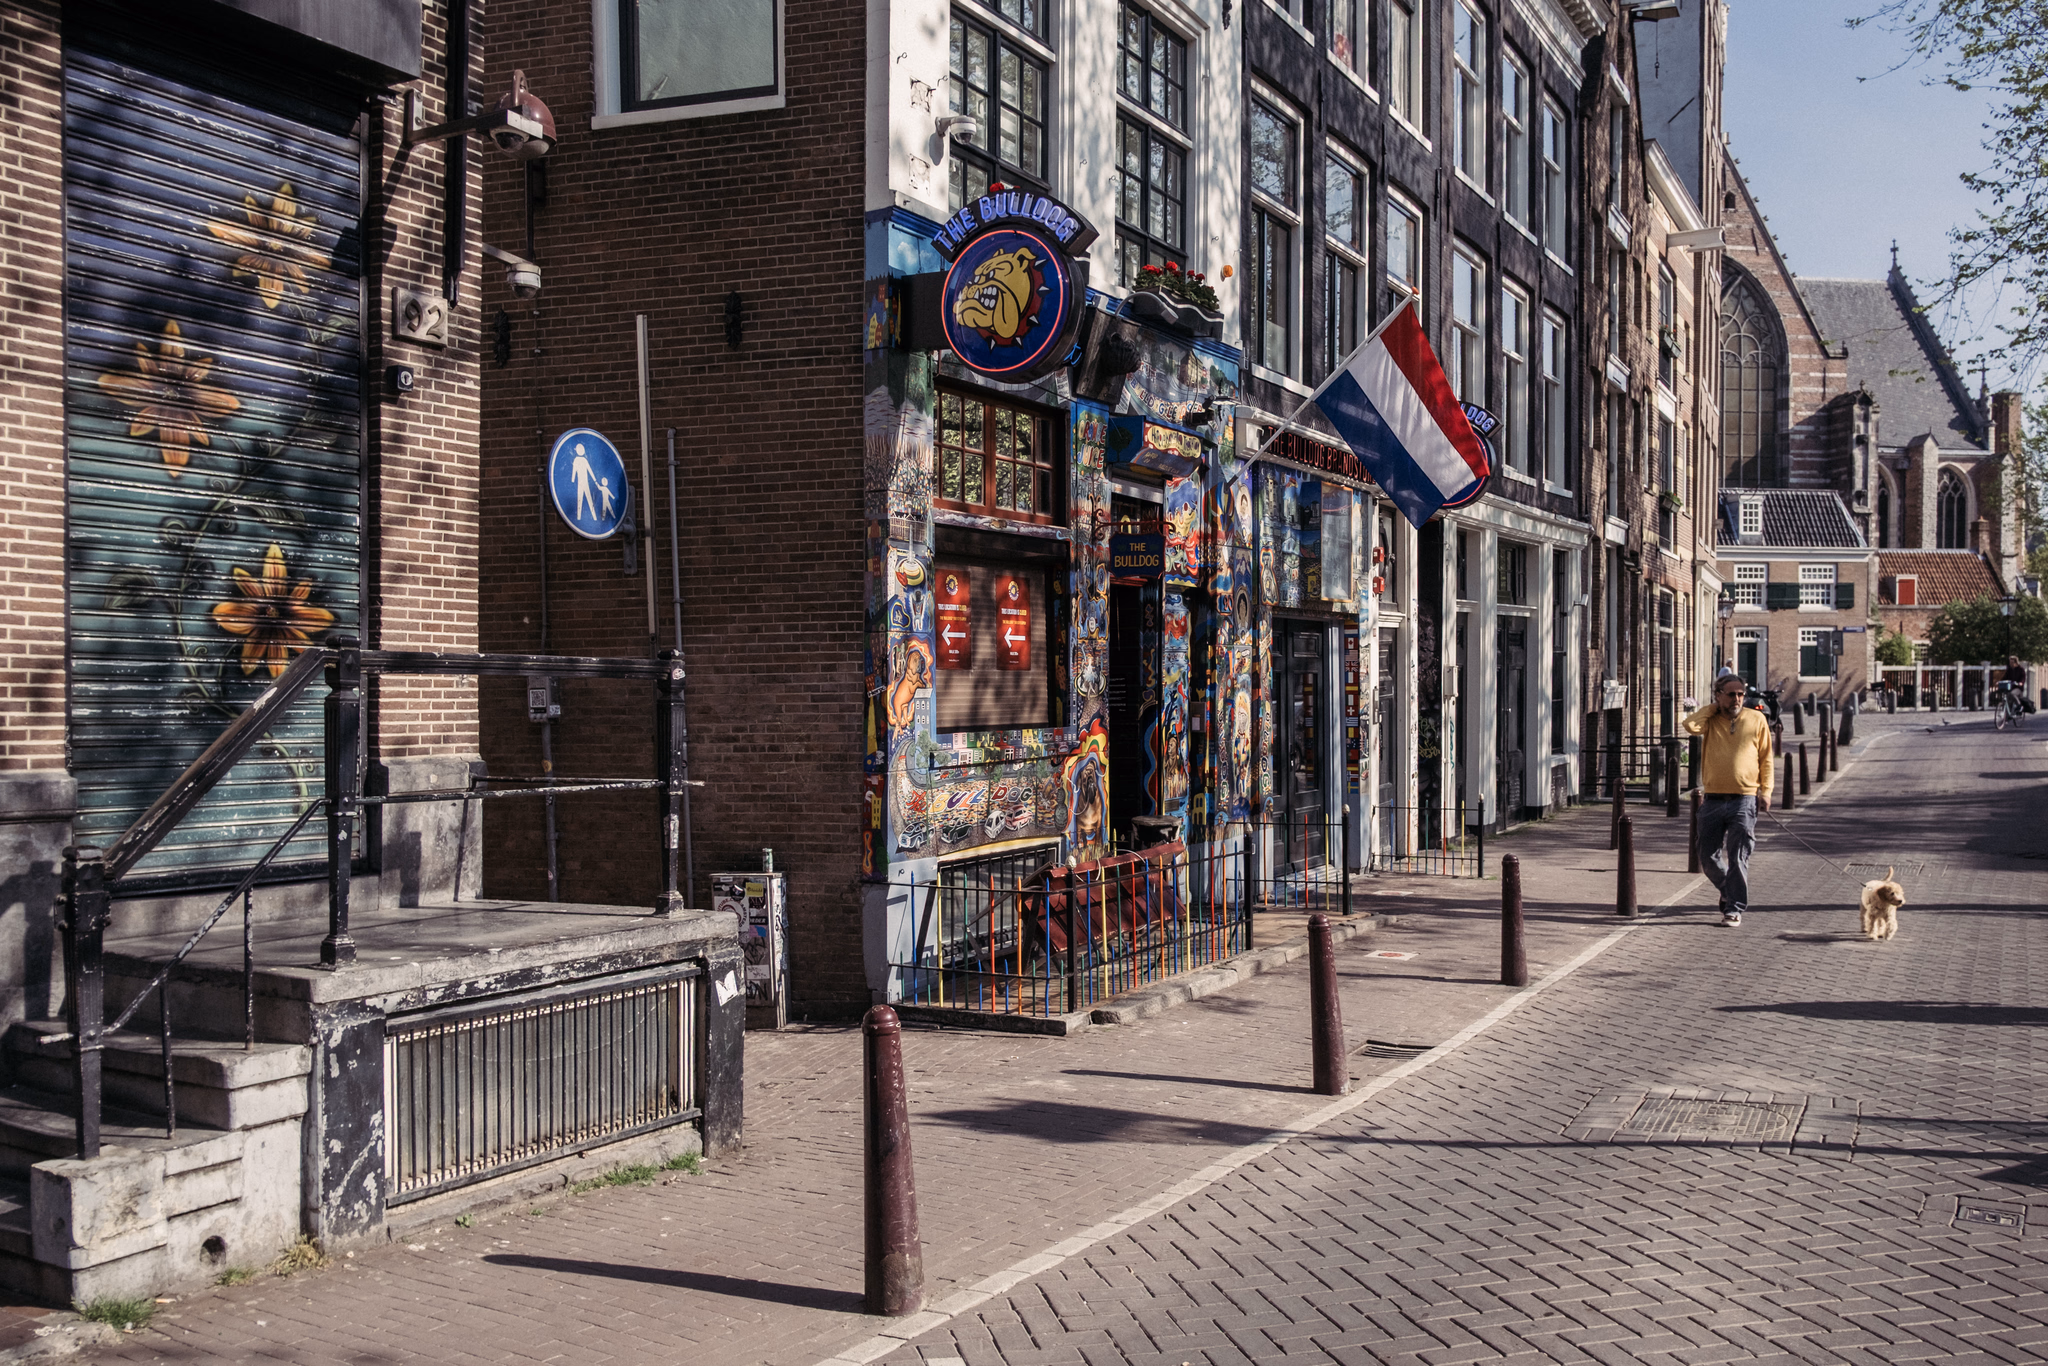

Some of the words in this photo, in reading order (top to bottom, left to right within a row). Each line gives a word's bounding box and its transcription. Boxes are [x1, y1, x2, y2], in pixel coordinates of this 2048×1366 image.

[934, 207, 979, 252] THE
[978, 191, 1080, 243] BULLDOG
[405, 298, 445, 340] 92
[1077, 441, 1105, 469] JUICE
[1268, 425, 1286, 455] THE
[1287, 433, 1325, 468] BULLDOG
[1114, 554, 1160, 568] BULLDOG
[1129, 542, 1146, 552] THE
